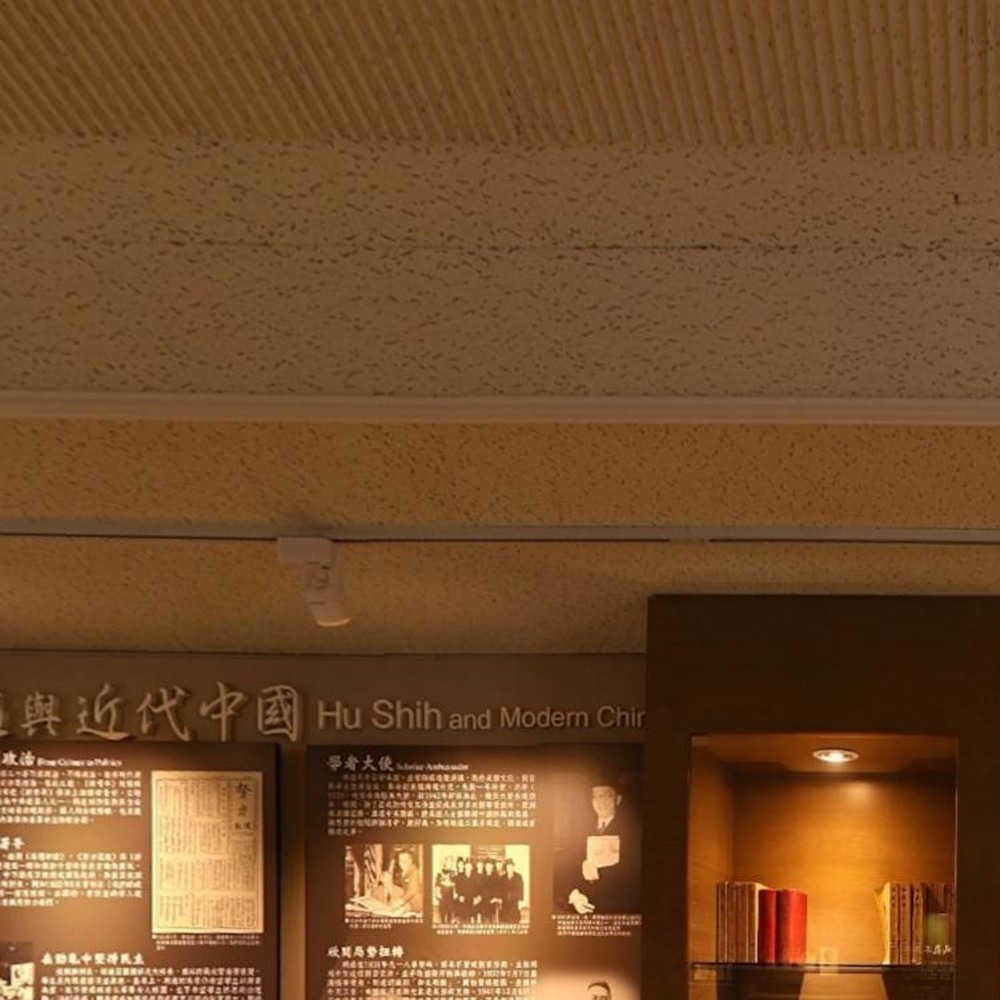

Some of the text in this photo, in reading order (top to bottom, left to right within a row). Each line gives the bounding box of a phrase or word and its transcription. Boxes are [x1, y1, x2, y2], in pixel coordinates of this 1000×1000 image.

[0, 682, 299, 742] 與近代中國
[317, 699, 646, 730] Hu Shih and Modern Chin
[327, 754, 395, 772] 學者大使
